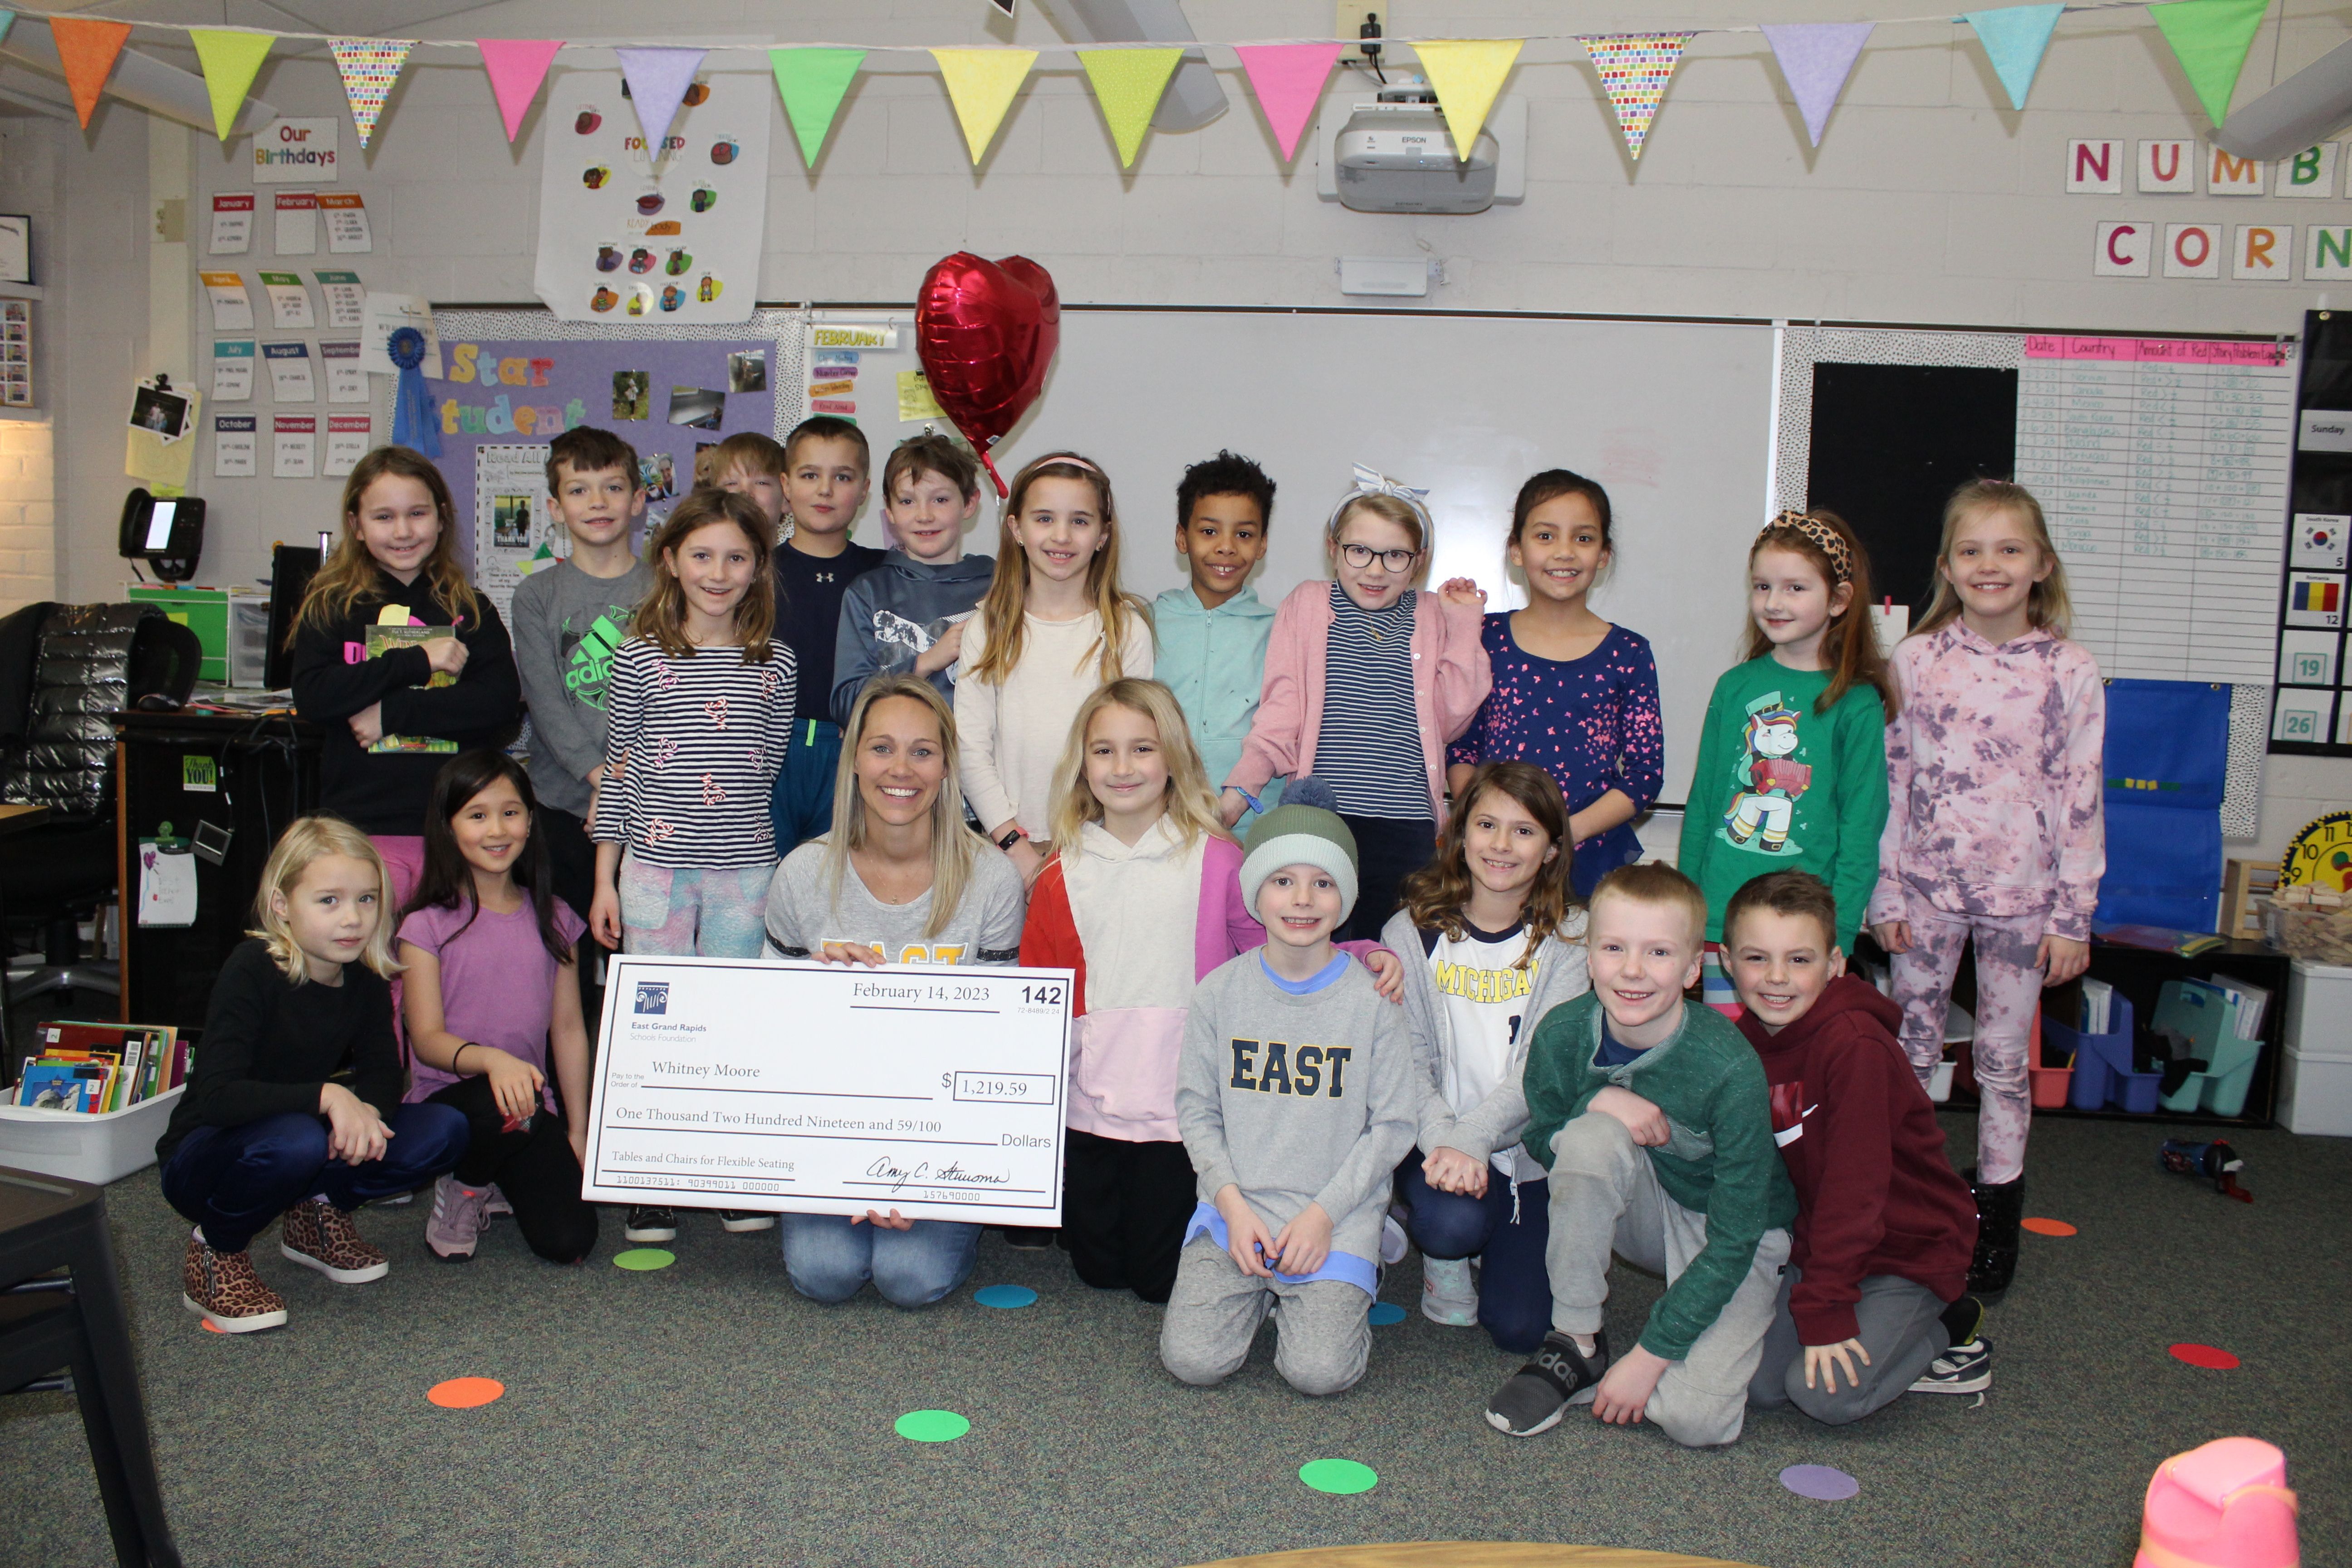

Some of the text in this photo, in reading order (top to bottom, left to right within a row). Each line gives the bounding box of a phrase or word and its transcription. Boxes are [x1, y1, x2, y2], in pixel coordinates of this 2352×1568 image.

[280, 126, 311, 142] Our
[625, 137, 685, 150] FOCSED
[256, 149, 335, 166] Birthdays
[219, 199, 249, 208] January
[276, 198, 315, 207] February
[627, 219, 649, 228] READY
[814, 330, 888, 346] FEBRUARY
[228, 346, 241, 354] July
[271, 346, 299, 355] August
[323, 346, 360, 355] Septembe
[2029, 336, 2055, 352] Date
[2072, 338, 2115, 359] Country
[2139, 342, 2172, 357] Amount
[2177, 342, 2186, 356] of
[2192, 343, 2206, 357] Red
[449, 343, 554, 387] Star
[438, 394, 586, 435] tudent
[219, 420, 251, 428] October
[275, 420, 314, 429] November
[329, 421, 369, 429] December
[2311, 425, 2345, 436] Sunday
[487, 452, 519, 463] Read
[2336, 557, 2343, 566] 5
[2326, 616, 2338, 625] 12
[2300, 660, 2320, 676] 19
[2287, 717, 2310, 733] 26
[186, 757, 213, 769] Thank
[186, 768, 213, 784] YOU!
[2325, 827, 2334, 842] 11
[2292, 867, 2302, 882] 9
[853, 983, 990, 1002] February 14, 2023
[1022, 986, 1061, 1004] 142
[680, 1024, 707, 1033] Rapids
[630, 1033, 696, 1043] Schools Foundation
[652, 1061, 760, 1079] Whitney Moore
[89, 1084, 95, 1092] 2
[942, 1072, 1027, 1096] $ 1,219.59
[616, 1107, 941, 1132] One Thousand Two Hundred Nineteen and 59/100
[1002, 1133, 1051, 1148] Dollars
[612, 1151, 795, 1171] Tables and Chairs for Flexible Seating
[742, 1181, 779, 1192] 000000
